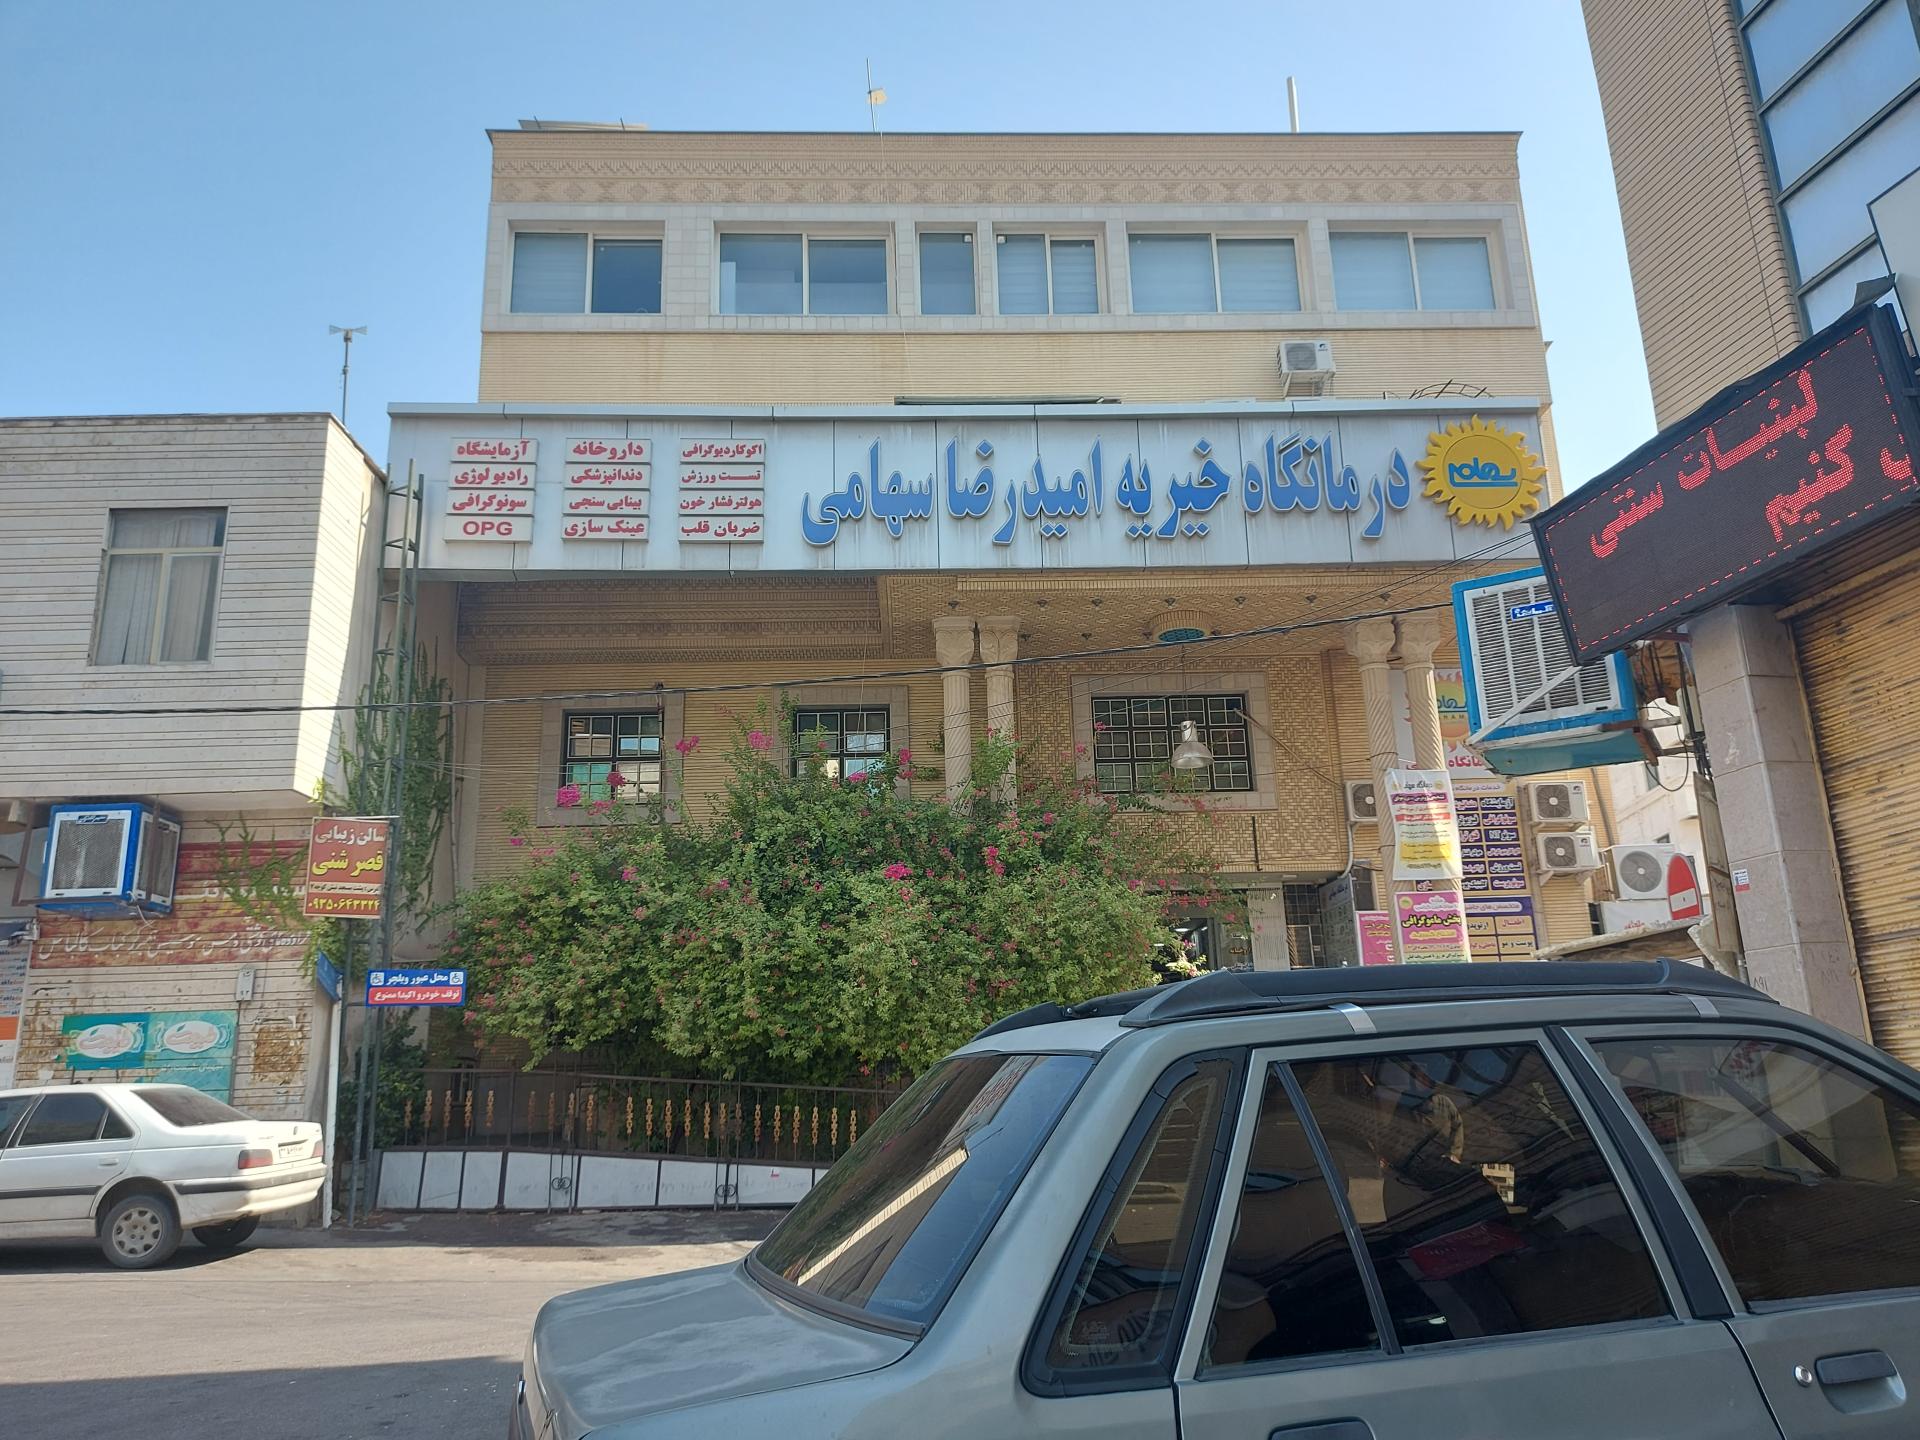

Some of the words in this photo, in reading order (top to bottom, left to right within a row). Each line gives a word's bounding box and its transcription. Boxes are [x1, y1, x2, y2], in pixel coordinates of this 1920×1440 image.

[1677, 369, 1818, 491] لبنیات
[456, 439, 530, 461] آزمایشگاه
[572, 440, 644, 461] داروخانه
[681, 442, 763, 462] اکوکاردیوگرافی
[454, 465, 530, 489] رادیولوژی
[570, 466, 644, 487] دندانپزشکی
[680, 468, 717, 486] ورزش
[718, 469, 761, 482] تست
[1243, 429, 1412, 541] درمانگاه
[1765, 422, 1855, 543] کنیم
[801, 436, 935, 546] سهامی
[451, 493, 528, 514] سونوگرافی
[568, 495, 605, 514] سنجی
[606, 496, 642, 514] بینایی
[679, 497, 708, 514] خون
[462, 520, 514, 537] OPG
[563, 519, 607, 539] سازی
[607, 520, 645, 536] عینک
[680, 519, 711, 538] قلب
[713, 520, 761, 539] ضربان
[1590, 481, 1665, 559] سنتی
[315, 825, 356, 845] زیبایی
[357, 827, 385, 846] سالن
[311, 849, 349, 875] شنی
[350, 850, 384, 878] قصر
[1401, 914, 1442, 928] ماموگرافی
[1442, 914, 1462, 926] بخش
[385, 973, 410, 986] ویلچر
[409, 974, 429, 985] عبور
[429, 972, 449, 984] محل
[440, 989, 460, 1000] توقف
